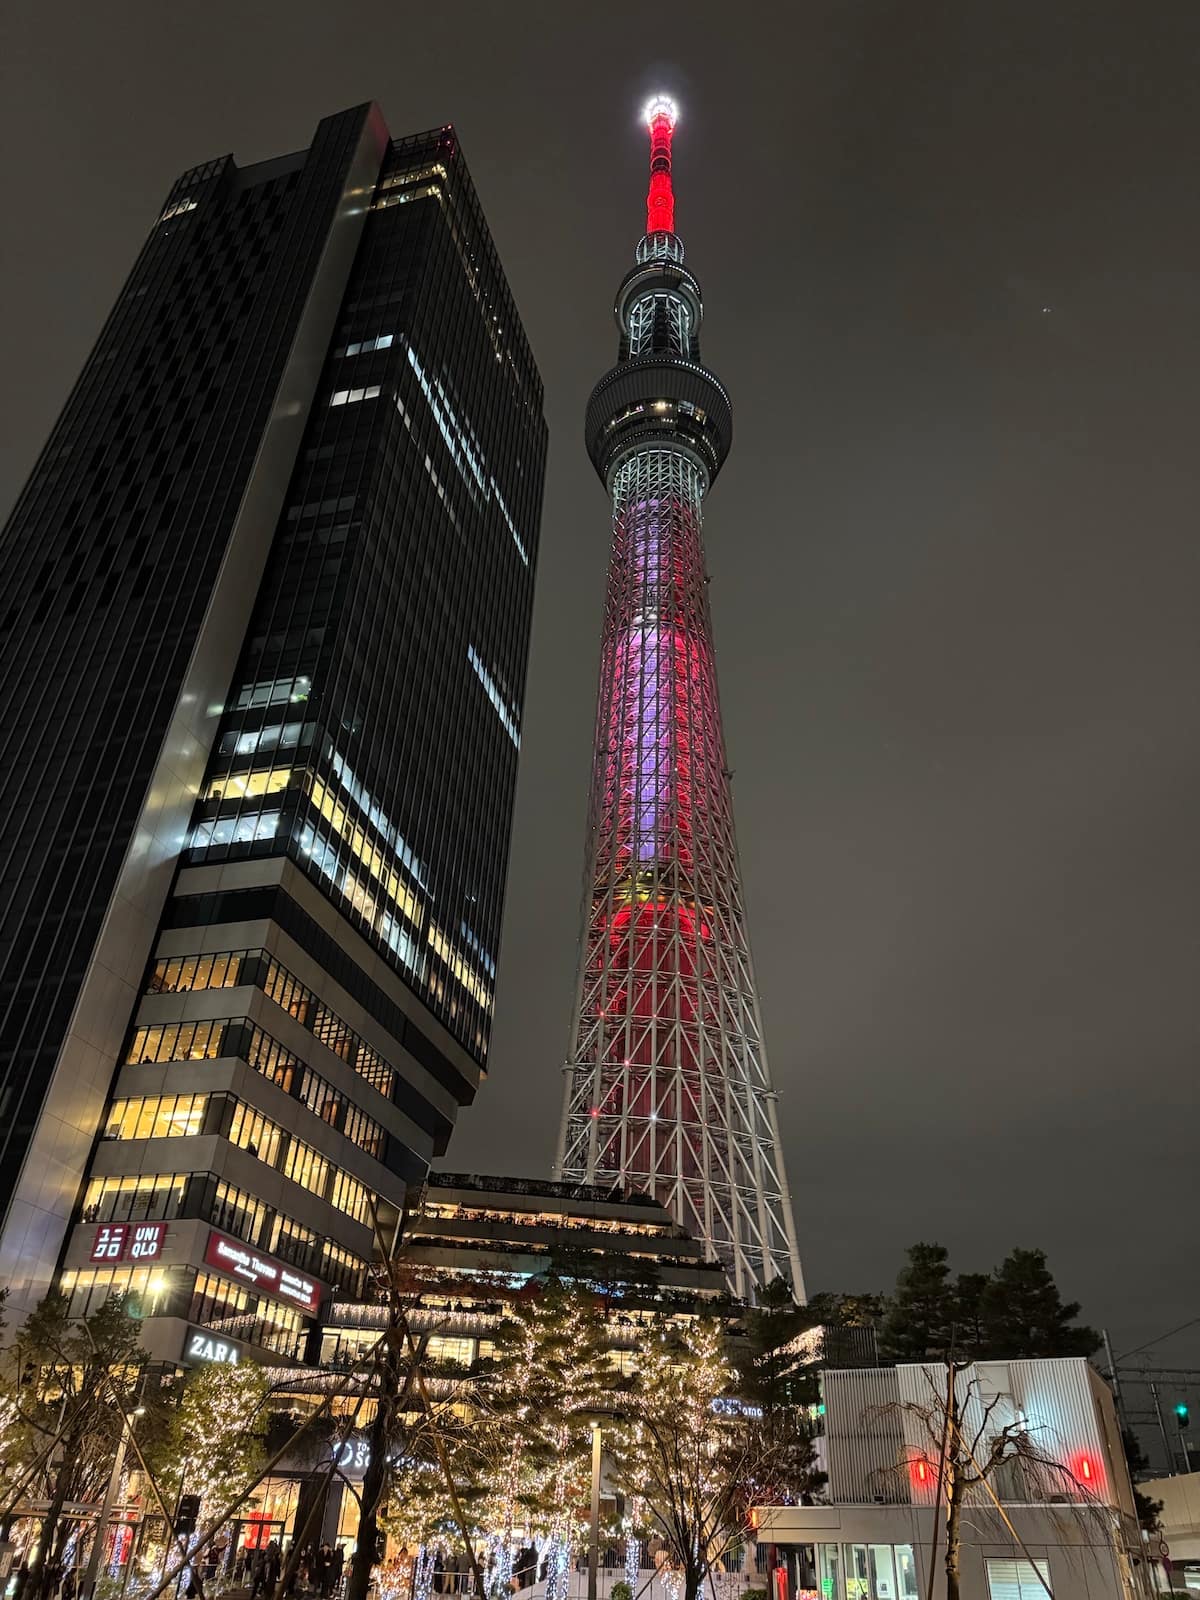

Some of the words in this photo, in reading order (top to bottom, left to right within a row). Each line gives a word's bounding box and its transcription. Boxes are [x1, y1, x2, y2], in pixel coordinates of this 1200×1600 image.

[135, 1227, 160, 1241] UNI
[131, 1241, 158, 1258] QLO
[190, 1335, 238, 1366] ZARA
